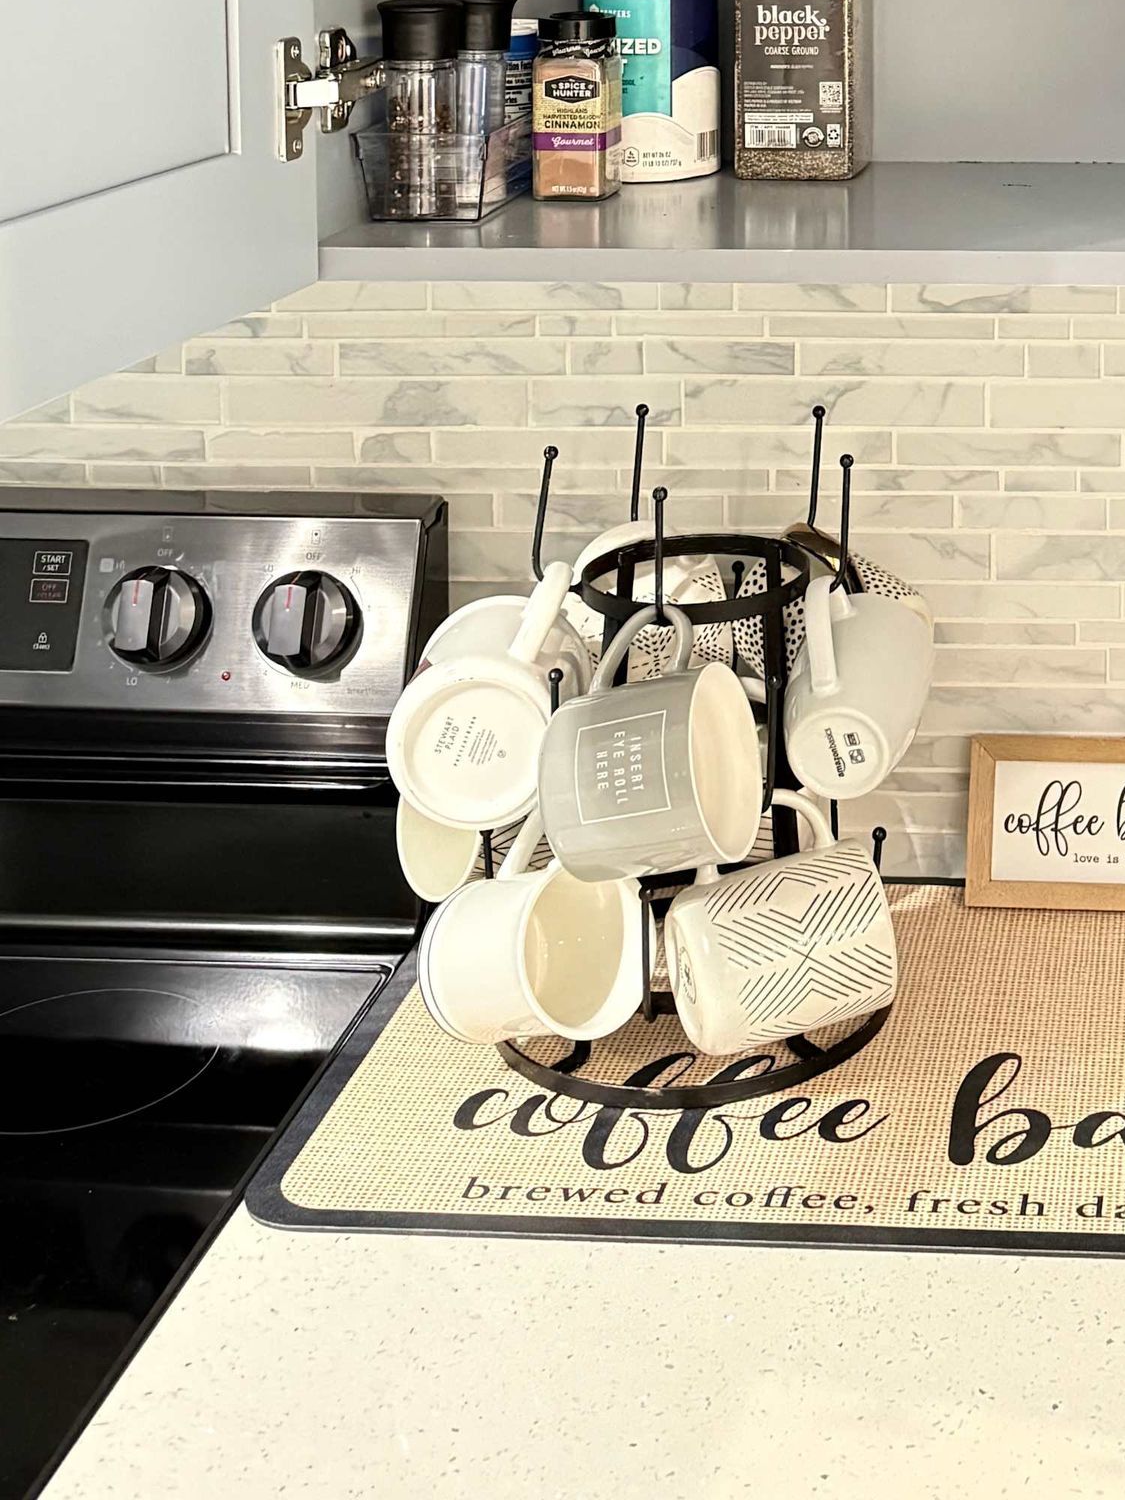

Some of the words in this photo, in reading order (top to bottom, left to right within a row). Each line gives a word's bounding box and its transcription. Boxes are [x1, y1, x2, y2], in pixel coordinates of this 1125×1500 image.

[756, 4, 827, 27] black
[754, 25, 831, 46] pepper
[617, 38, 661, 55] IZED
[764, 46, 790, 55] COARSE
[791, 46, 819, 55] GROUND
[552, 89, 592, 97] HUNTER
[558, 82, 586, 90] SPICE
[544, 120, 600, 129] CINNAMON
[551, 136, 594, 148] Gourmet
[41, 555, 66, 564] START
[157, 549, 173, 557] OFF
[306, 552, 321, 561] OFF
[434, 716, 454, 754] STEWART
[444, 725, 460, 750] PLAID
[612, 731, 626, 759] EYE
[596, 750, 609, 790] HERE
[629, 736, 645, 791] INSERT
[613, 767, 629, 805] ROLL
[1003, 780, 1105, 857] coffee
[1073, 853, 1100, 863] love
[1106, 854, 1120, 864] is
[461, 1177, 667, 1206] brewed
[693, 1185, 874, 1215] coffee,
[905, 1189, 1046, 1219] fresh
